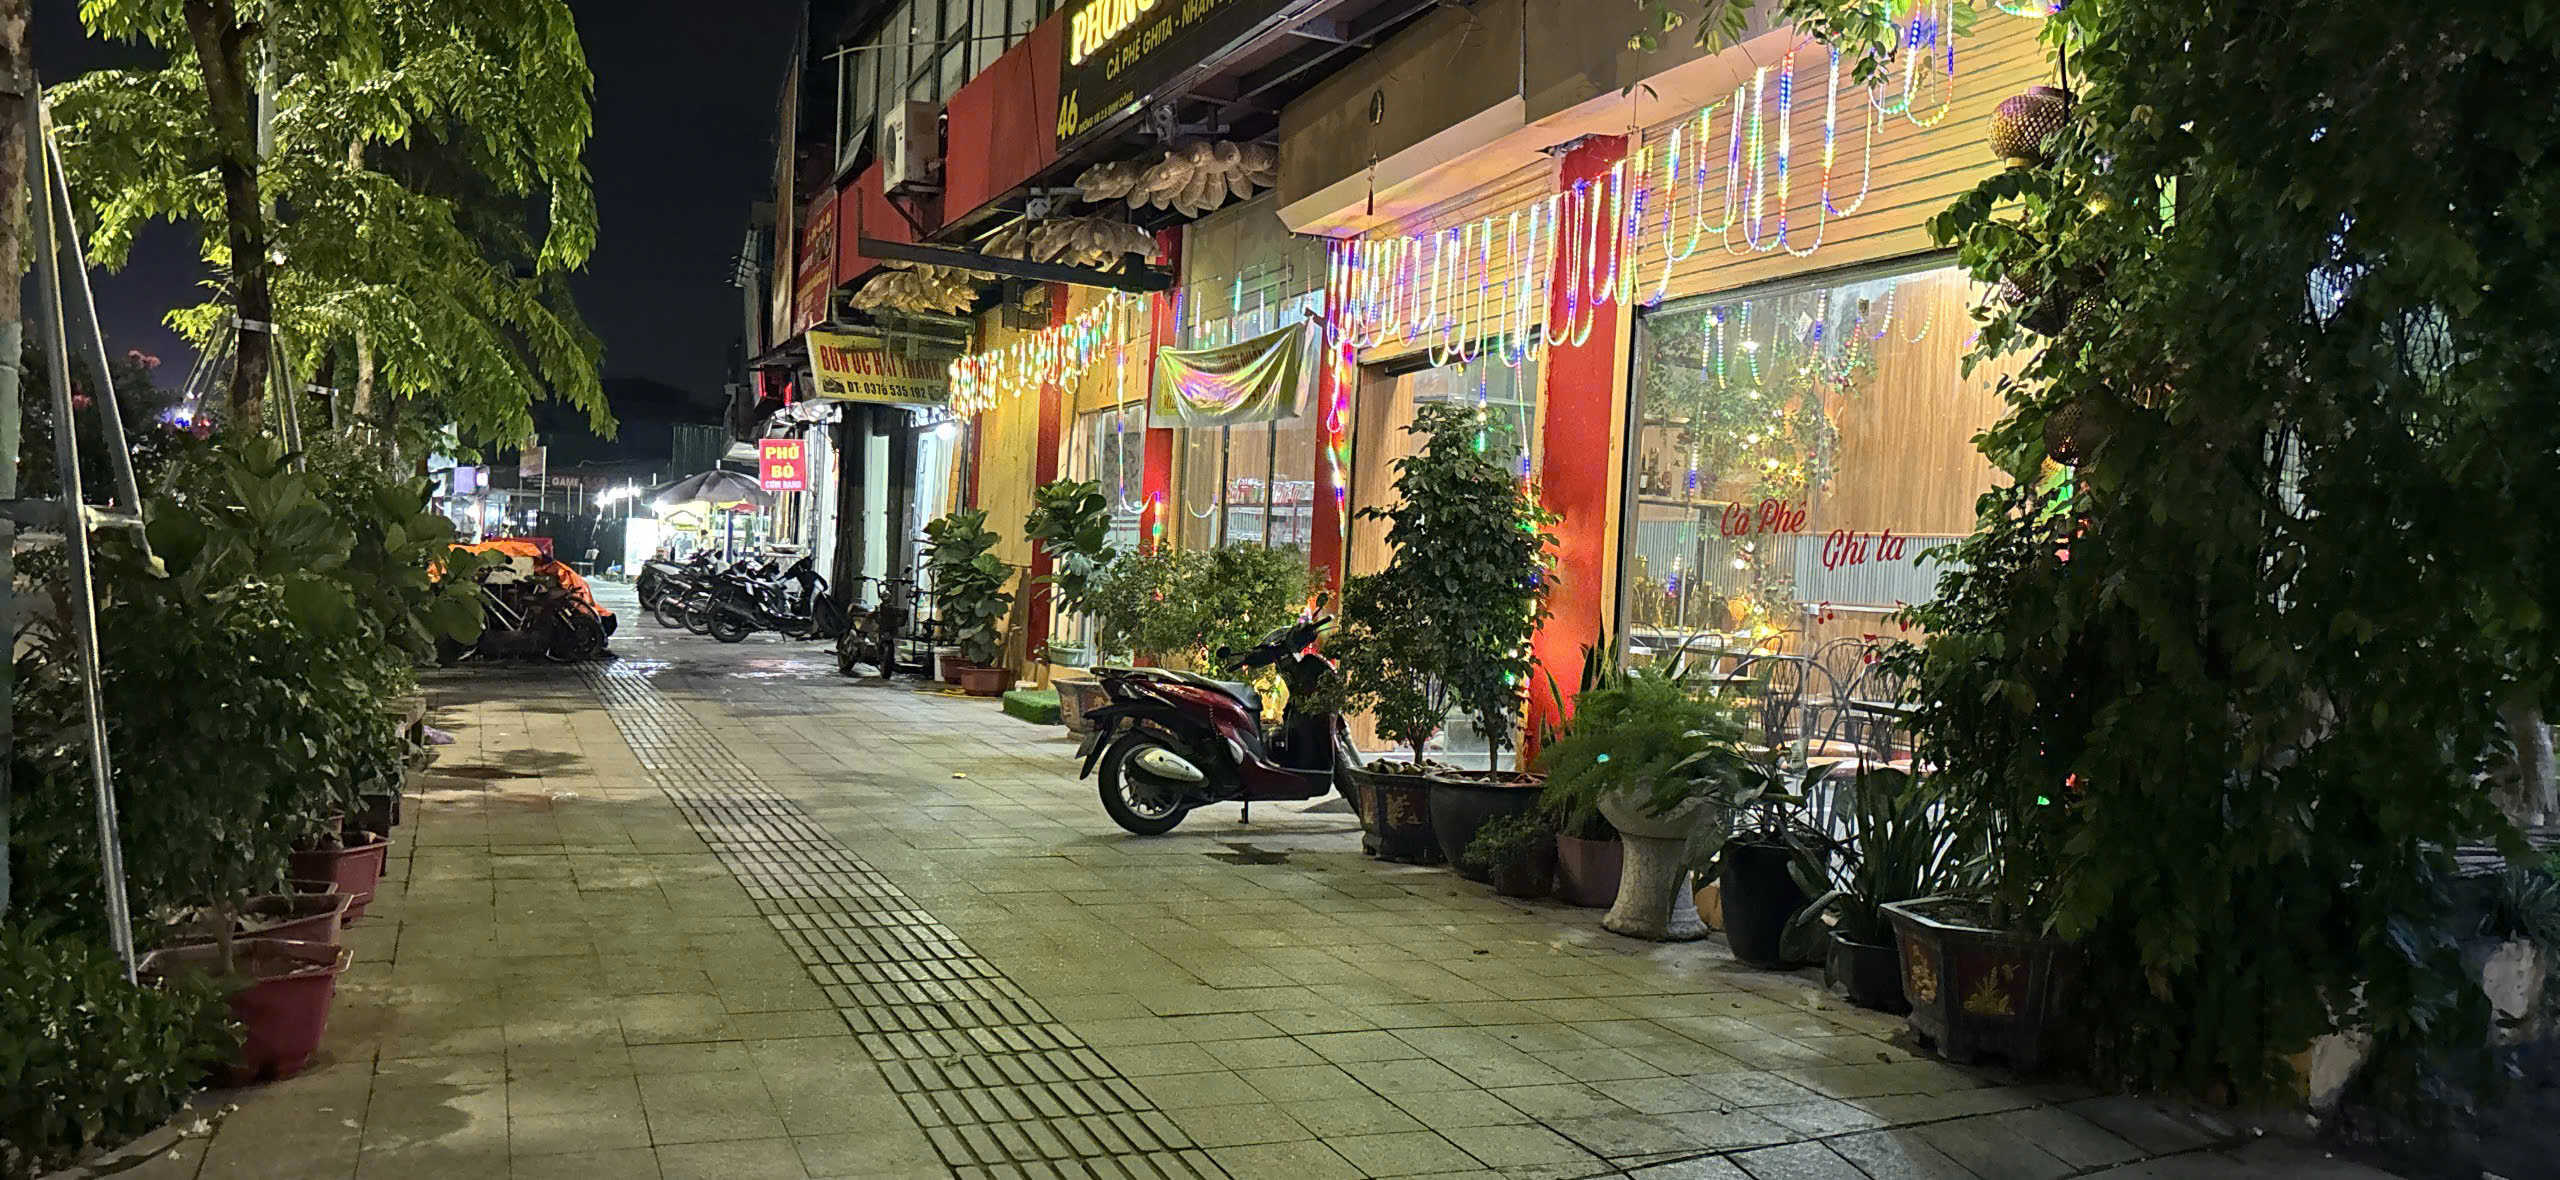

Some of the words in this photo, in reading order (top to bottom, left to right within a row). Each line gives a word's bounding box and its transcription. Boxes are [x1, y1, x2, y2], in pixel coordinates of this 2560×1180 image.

[1142, 14, 1173, 55] GHITA
[1056, 88, 1079, 141] 46
[889, 384, 909, 398] 535
[765, 442, 800, 460] PHỞ
[551, 476, 580, 487] GAME
[771, 462, 794, 479] BÒ
[1757, 498, 1809, 535] Phê
[1822, 528, 1870, 571] Ghi
[1876, 528, 1906, 563] ta
